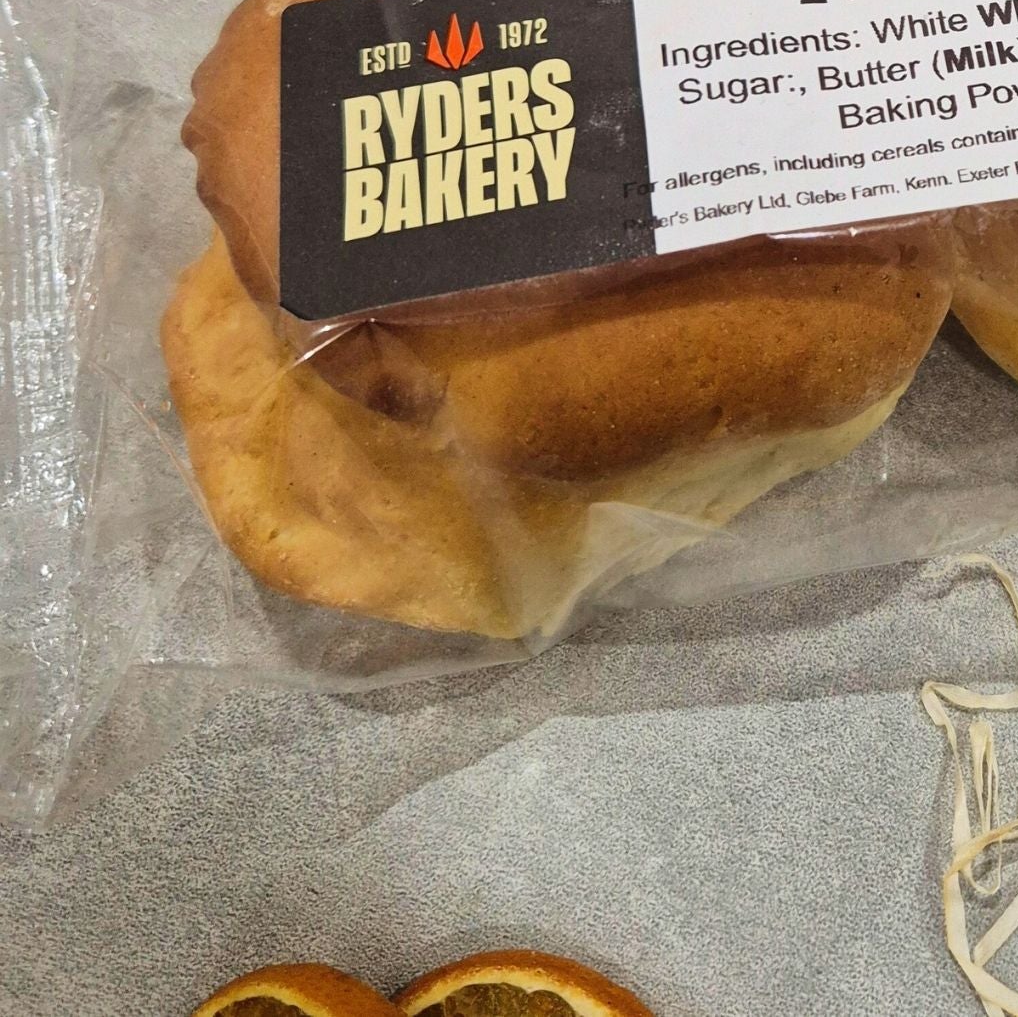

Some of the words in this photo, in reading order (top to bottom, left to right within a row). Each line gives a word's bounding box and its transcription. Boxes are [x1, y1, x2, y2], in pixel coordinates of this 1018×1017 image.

[360, 41, 411, 76] ESTD
[498, 17, 548, 49] 1972
[660, 28, 861, 69] Ingredients:
[870, 11, 968, 44] White
[678, 72, 807, 106] Sugar:,
[817, 56, 920, 91] Butter
[341, 58, 575, 170] RYDERS
[838, 92, 958, 130] Baking
[342, 127, 576, 242] BAKERY
[623, 181, 657, 199] For
[666, 160, 768, 192] allergens,
[774, 150, 865, 172] including
[872, 138, 945, 162] cereals
[694, 199, 753, 222] Bakery
[796, 189, 847, 206] Glebe
[957, 163, 1009, 184] Exeter
